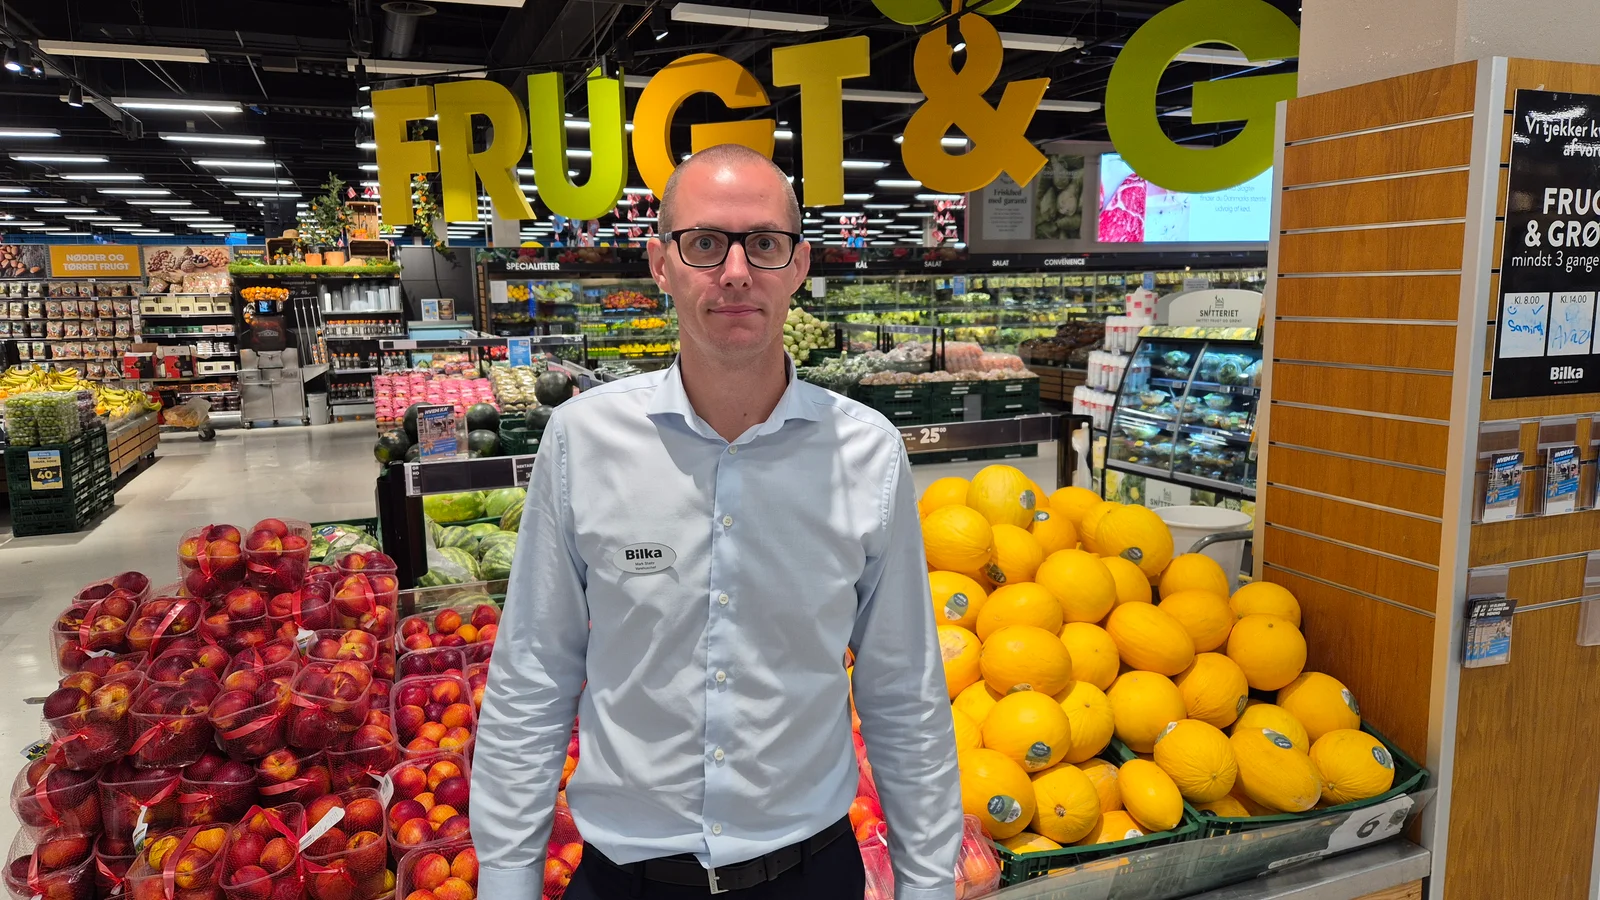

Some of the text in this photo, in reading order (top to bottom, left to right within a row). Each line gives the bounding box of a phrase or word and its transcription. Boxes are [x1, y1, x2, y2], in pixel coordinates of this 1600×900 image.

[371, 35, 870, 226] FRUGT
[901, 10, 1050, 195] &
[1525, 116, 1539, 134] Vi
[1543, 119, 1587, 142] tjekker
[1524, 220, 1542, 248] &
[506, 262, 560, 270] SPECIALITETER
[855, 260, 868, 269] KÅL
[1512, 250, 1599, 272] mindst 3 gange
[1524, 296, 1540, 304] 8.00
[1570, 295, 1587, 303] 14.00
[1200, 305, 1238, 317] SNITTERIET
[1550, 366, 1583, 380] Bilka
[625, 549, 662, 560] Bilka
